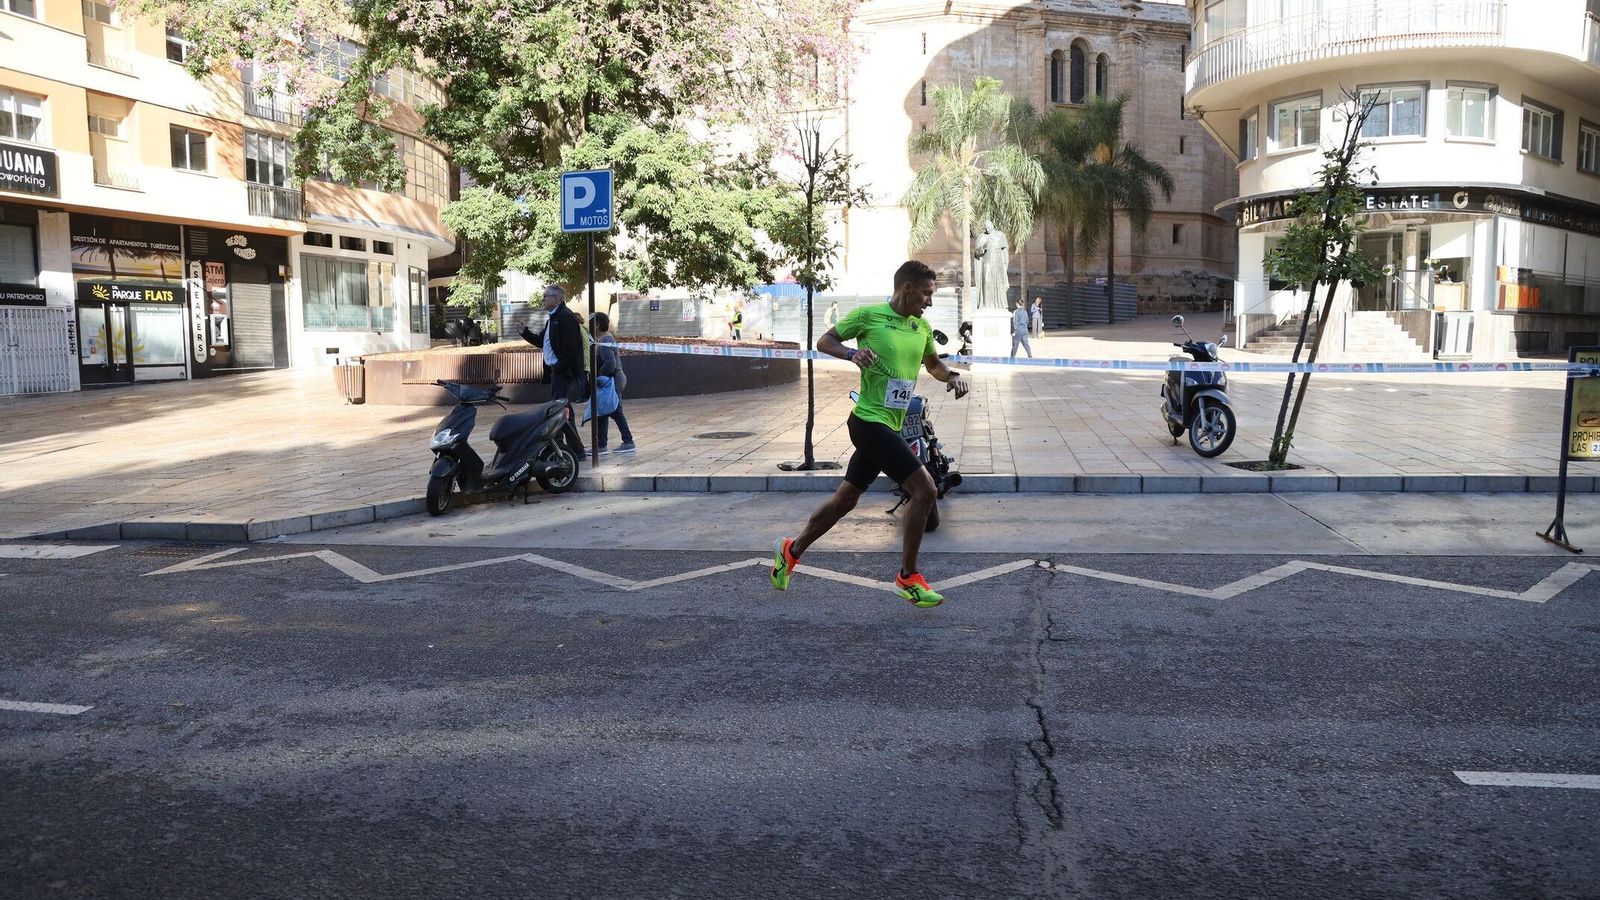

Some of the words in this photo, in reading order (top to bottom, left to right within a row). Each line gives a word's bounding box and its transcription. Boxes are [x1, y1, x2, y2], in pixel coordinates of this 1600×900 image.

[565, 176, 596, 225] P
[1366, 195, 1430, 209] ESTATE
[580, 215, 609, 226] MOTOS
[72, 235, 97, 243] GESTIÓN
[109, 239, 148, 248] APARTAMENTOS
[150, 242, 180, 251] TURÍSTICOS
[205, 265, 224, 275] ATM
[6, 293, 44, 301] PATRIMONIO
[112, 289, 142, 300] PARQUE
[144, 290, 174, 302] FLATS
[193, 270, 204, 352] SNEAKERS
[1571, 443, 1587, 453] LAS
